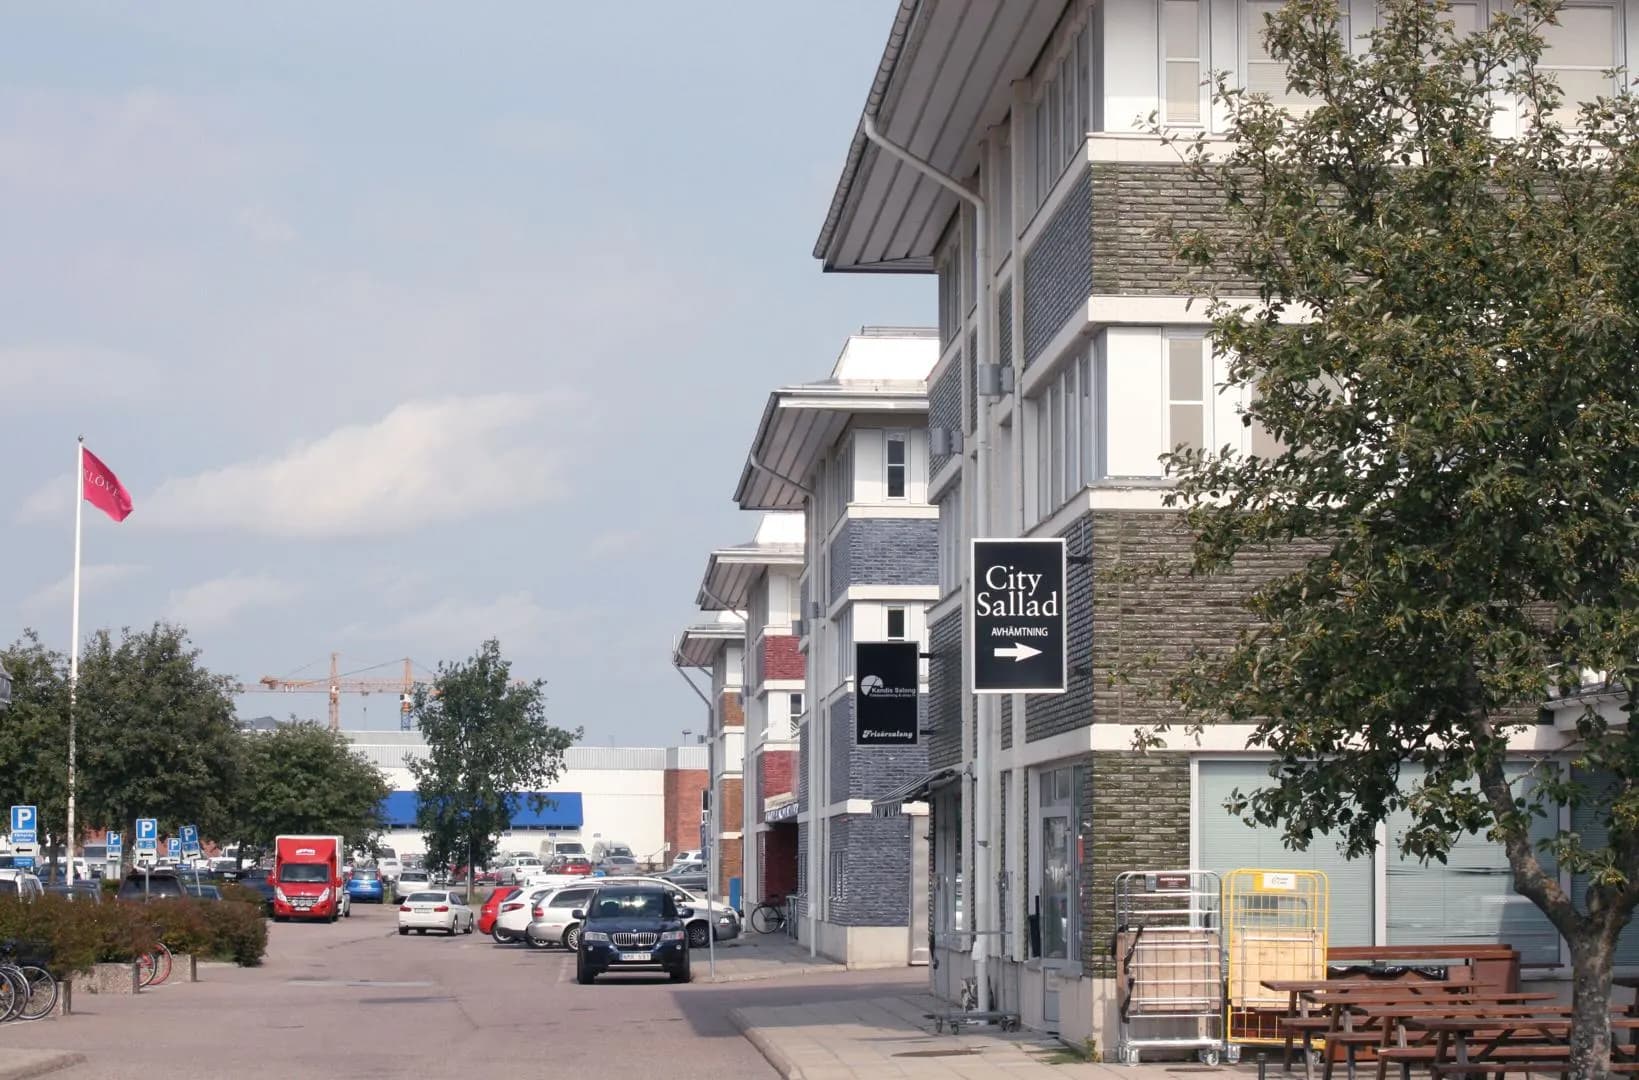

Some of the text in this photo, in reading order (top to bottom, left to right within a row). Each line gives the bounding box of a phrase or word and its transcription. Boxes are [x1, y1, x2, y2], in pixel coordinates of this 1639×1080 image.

[986, 565, 1043, 596] City
[976, 591, 1058, 616] Sallad
[991, 626, 1048, 636] AVHÄMTNING
[17, 808, 32, 829] P
[141, 821, 153, 838] P
[184, 828, 194, 841] P
[110, 834, 119, 845] P
[171, 839, 179, 850] P
